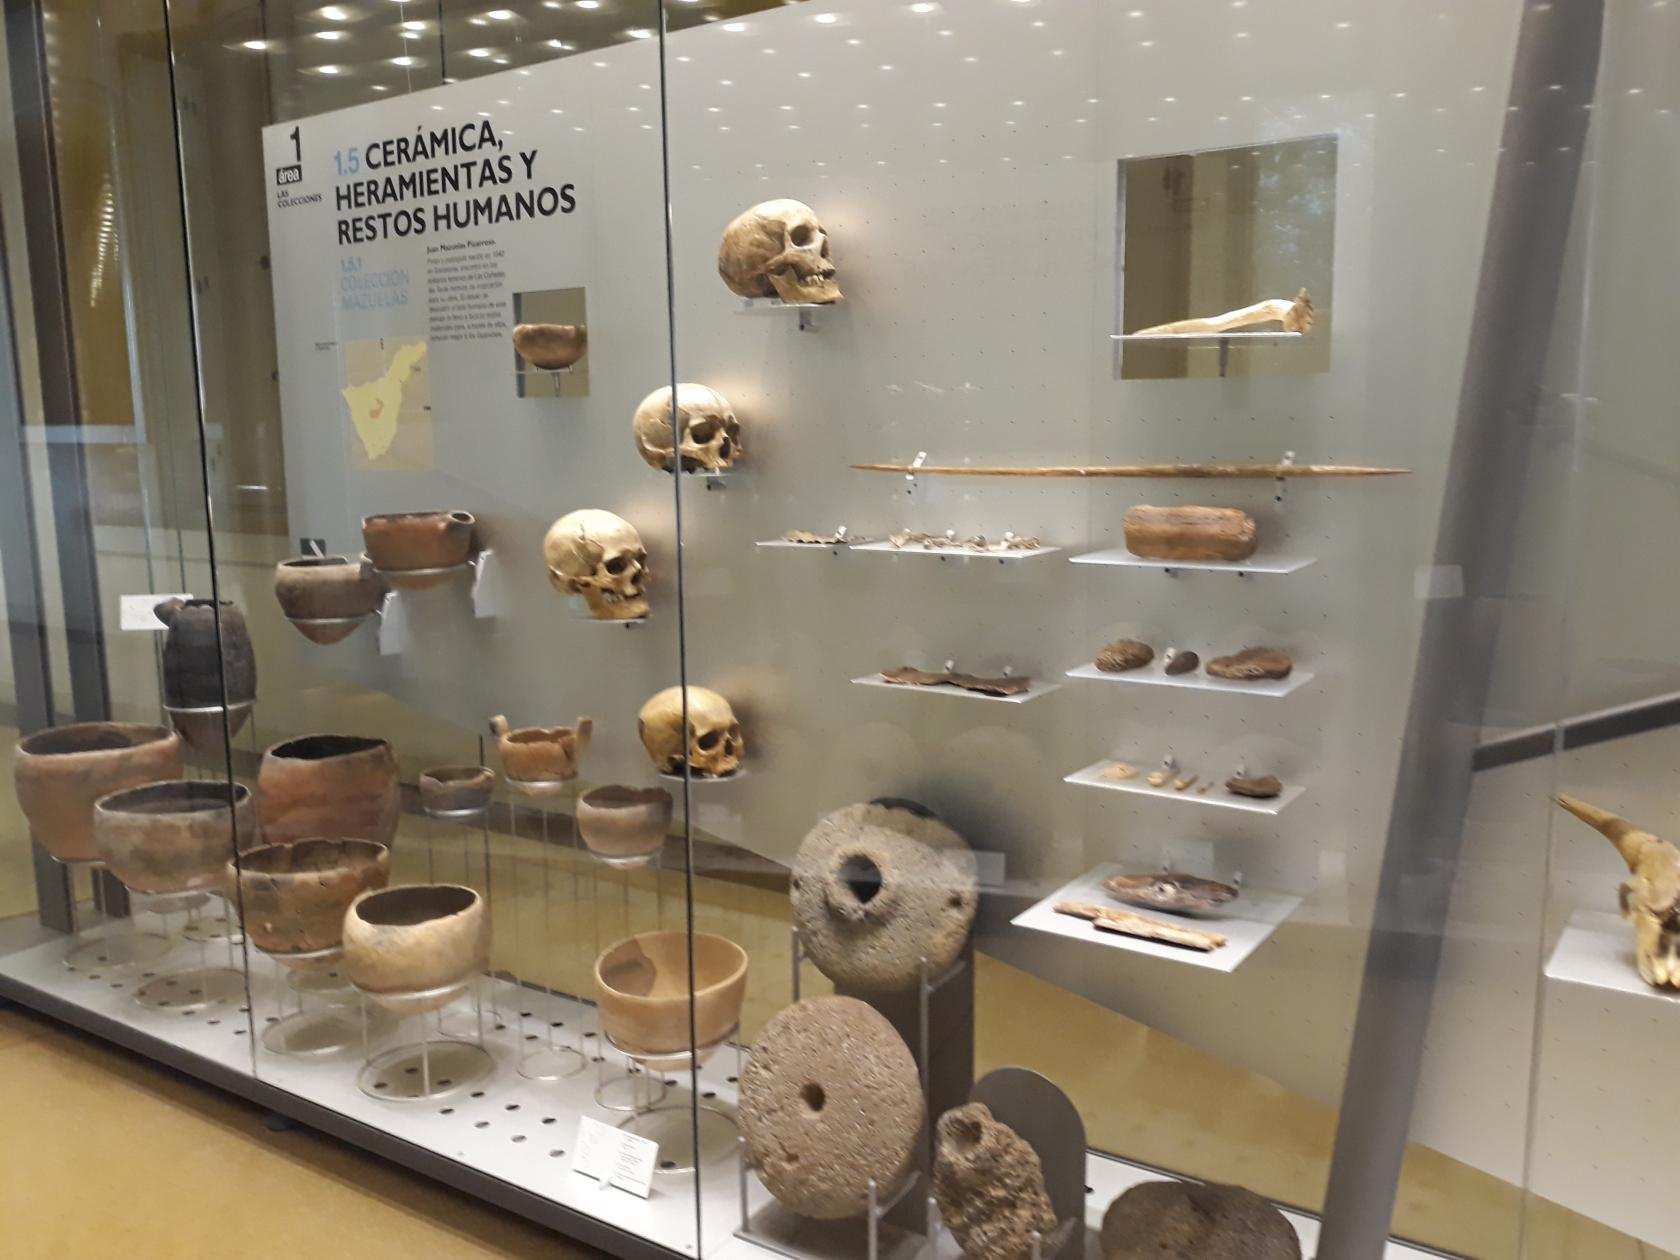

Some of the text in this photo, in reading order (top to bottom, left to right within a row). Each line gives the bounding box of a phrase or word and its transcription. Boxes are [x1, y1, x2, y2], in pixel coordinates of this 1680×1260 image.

[290, 126, 301, 162] 1
[335, 120, 503, 176] 1.5 CERÁMICA,
[278, 168, 300, 184] área
[336, 149, 538, 211] HERAMIENTAS Y
[277, 193, 322, 208] COLECCIONES
[338, 183, 576, 245] RESTOS HUMANOS
